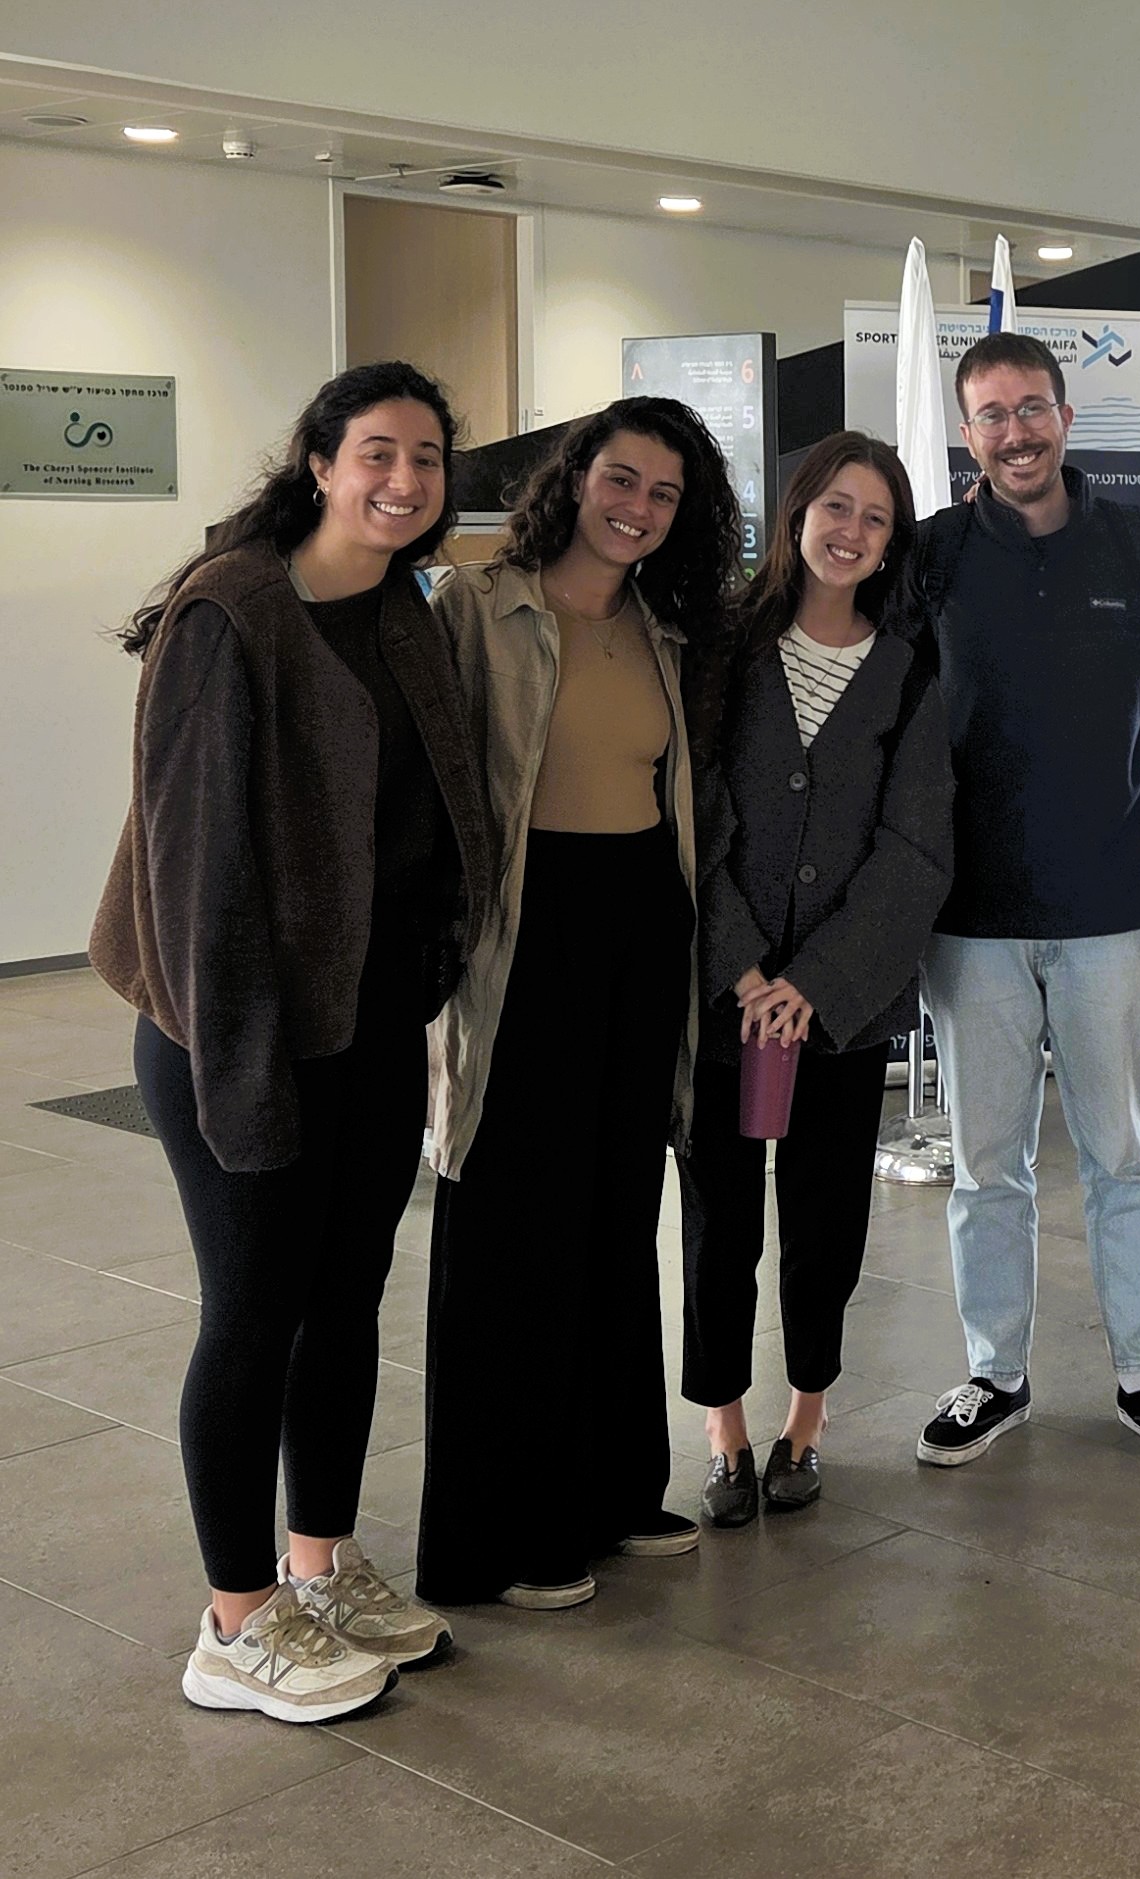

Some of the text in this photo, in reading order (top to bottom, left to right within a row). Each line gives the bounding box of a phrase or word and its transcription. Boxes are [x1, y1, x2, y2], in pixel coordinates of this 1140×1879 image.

[855, 331, 898, 345] SPORT
[1050, 327, 1077, 338] מרכז
[740, 359, 755, 384] 6
[3, 383, 34, 392] ספנסר
[36, 383, 59, 393] שריל
[86, 386, 117, 396] בסיעוד
[120, 388, 144, 397] מחקר
[147, 389, 169, 398] מרכז
[742, 405, 755, 429] 5
[22, 463, 154, 475] The Cheryl Spencer Institute
[43, 476, 135, 487] of Nursing Research
[743, 480, 756, 504] 4
[743, 524, 756, 548] 3
